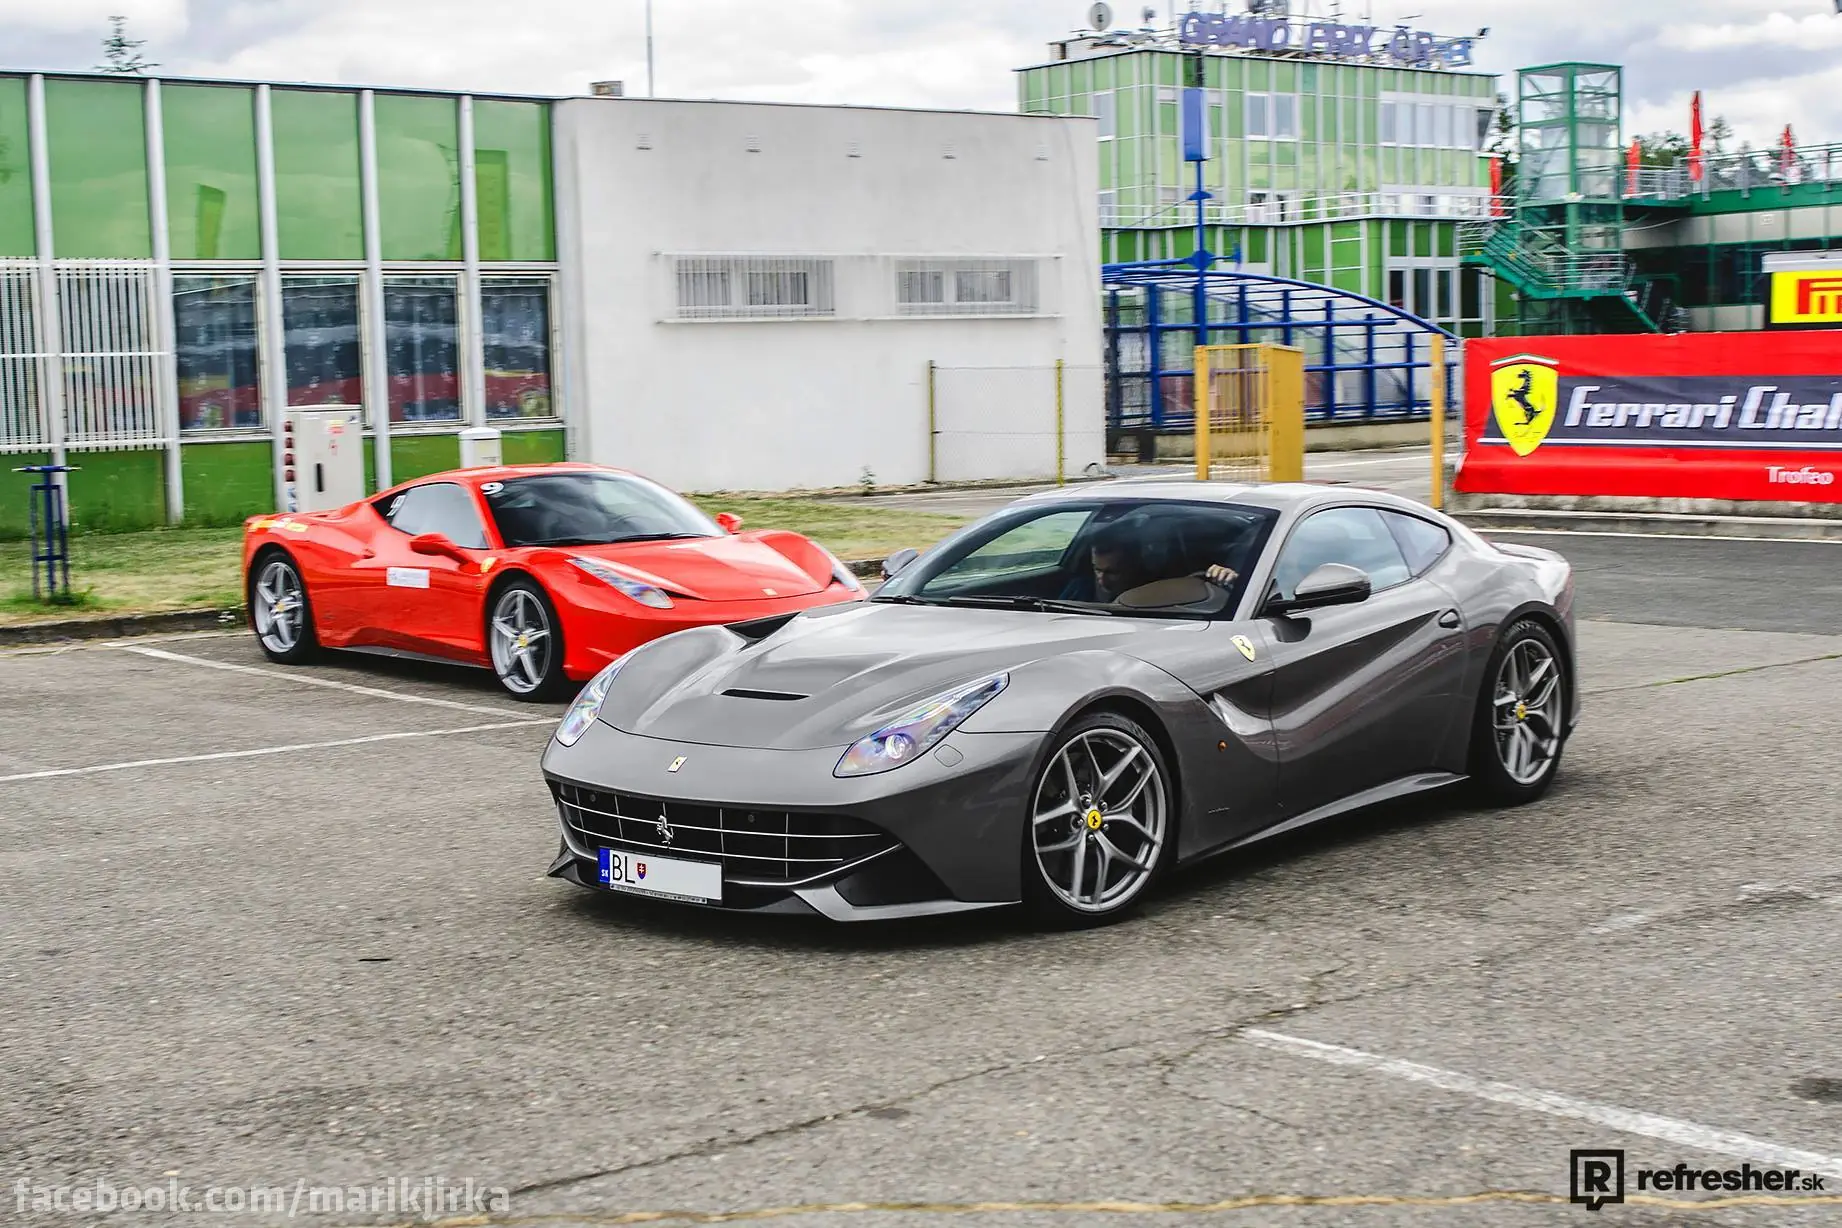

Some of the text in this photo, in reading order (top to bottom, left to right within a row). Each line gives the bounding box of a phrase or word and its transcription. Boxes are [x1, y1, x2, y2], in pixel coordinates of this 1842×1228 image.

[1564, 386, 1842, 429] Ferrari Chal
[1764, 467, 1834, 485] Trofeo
[612, 854, 635, 884] BL
